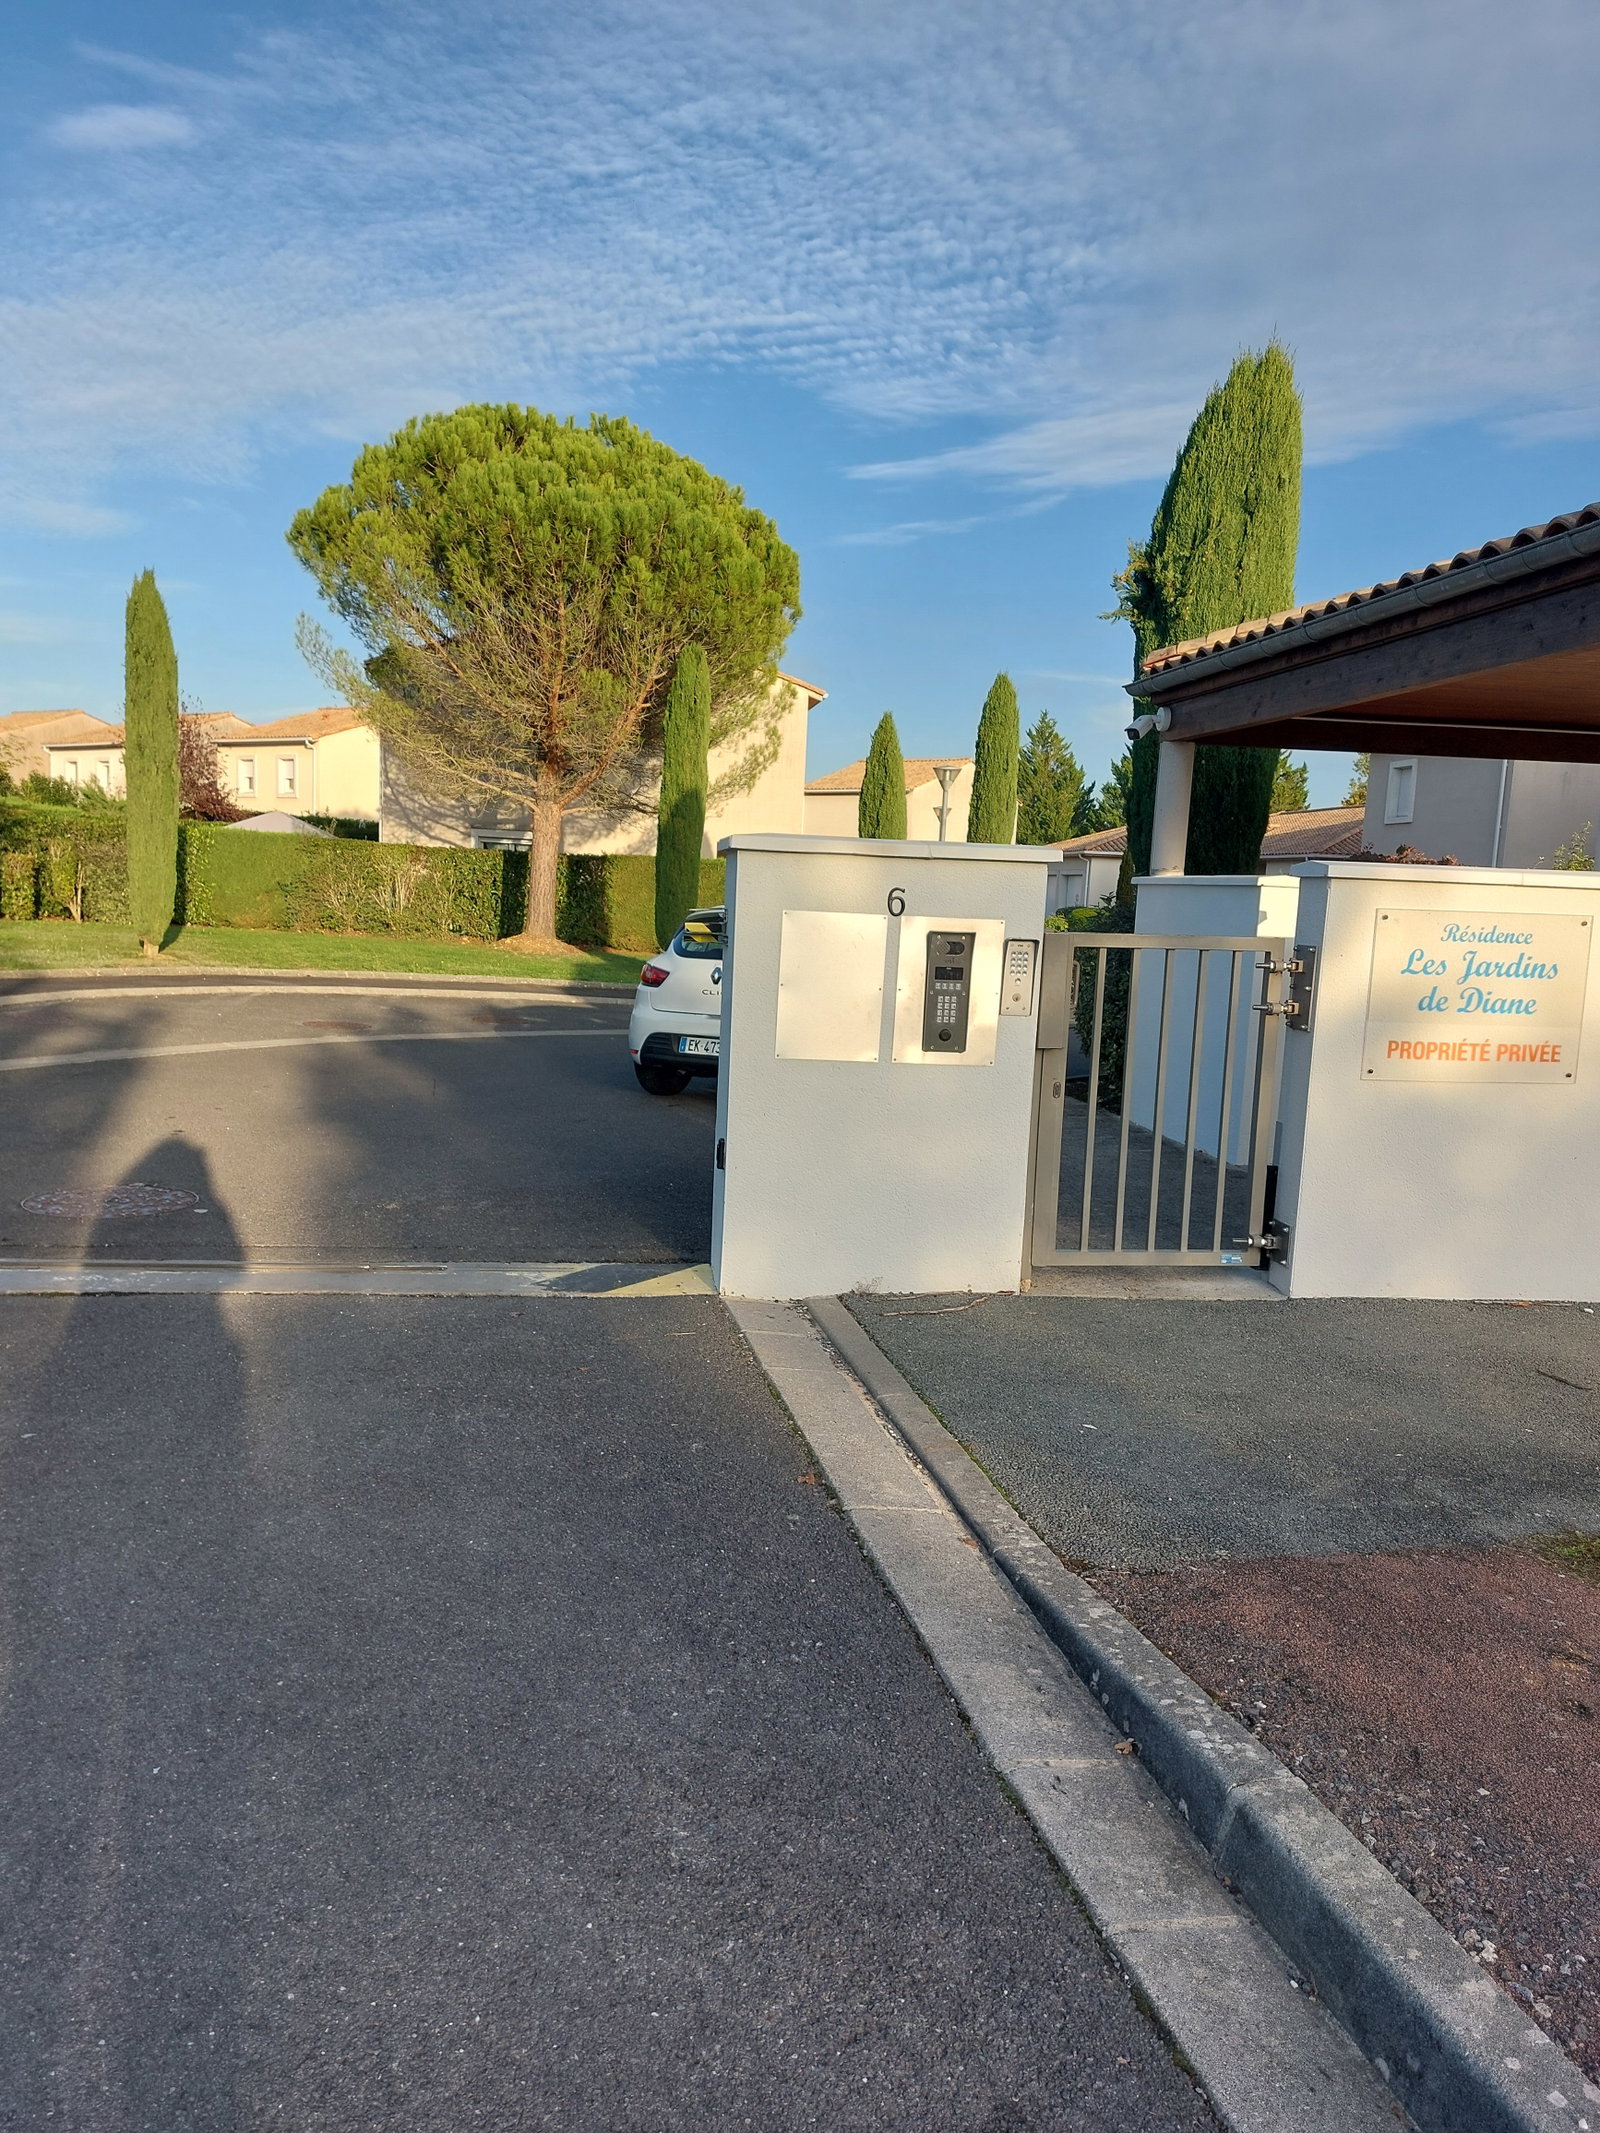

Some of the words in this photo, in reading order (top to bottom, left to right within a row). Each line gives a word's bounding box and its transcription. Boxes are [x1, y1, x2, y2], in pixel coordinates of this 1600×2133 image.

[887, 887, 906, 917] 6
[1441, 923, 1533, 945] Résidence
[1401, 948, 1448, 976] Les
[1457, 950, 1559, 985] Jardins
[1418, 986, 1449, 1012] de
[1457, 986, 1537, 1015] Diane
[1386, 1038, 1491, 1061] PROPRIÉTÉ
[1496, 1041, 1562, 1063] PRIVÉE
